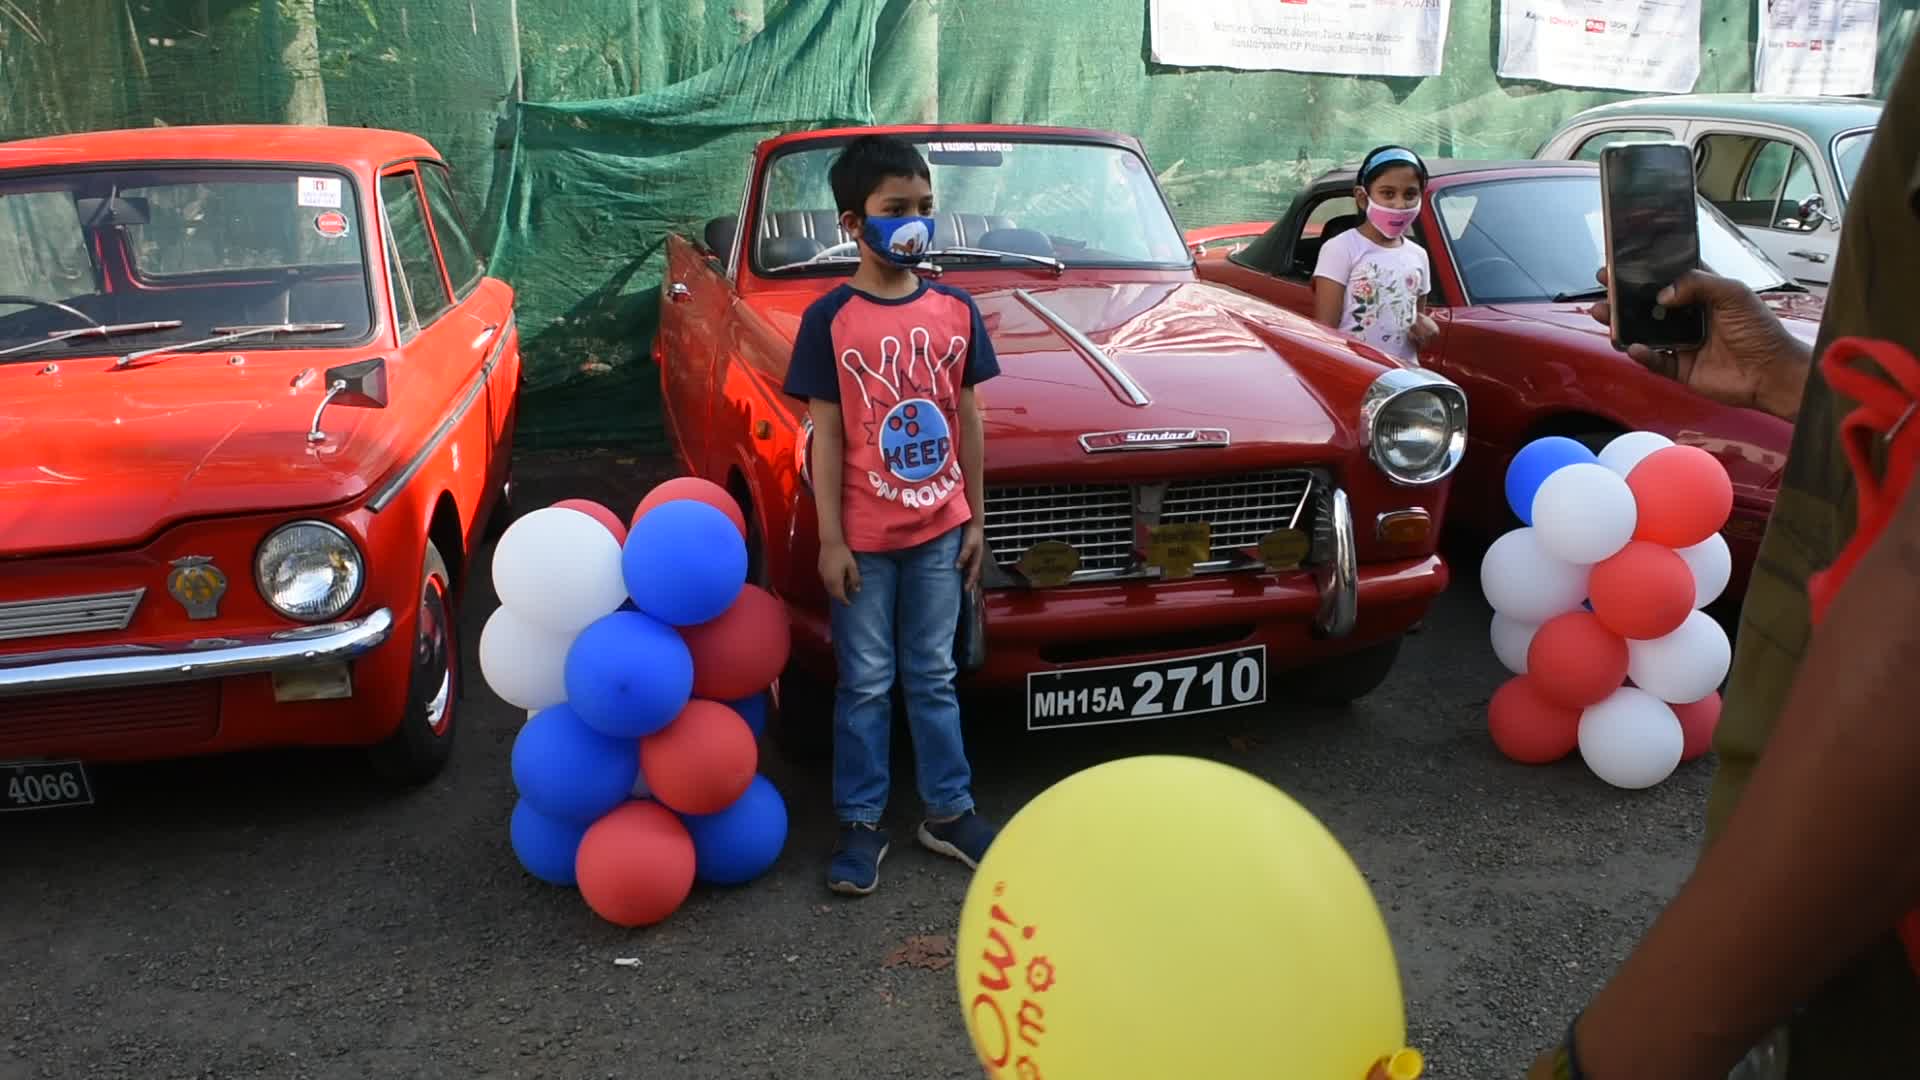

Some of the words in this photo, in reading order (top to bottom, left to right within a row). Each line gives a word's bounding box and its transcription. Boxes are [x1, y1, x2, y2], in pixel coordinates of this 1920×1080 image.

[927, 142, 943, 152] THE
[1126, 429, 1196, 442] Standard
[883, 436, 950, 472] KEEP
[868, 470, 899, 501] ON
[1034, 686, 1125, 718] MH15A
[1131, 656, 1260, 716] 2710
[7, 771, 80, 804] 4066
